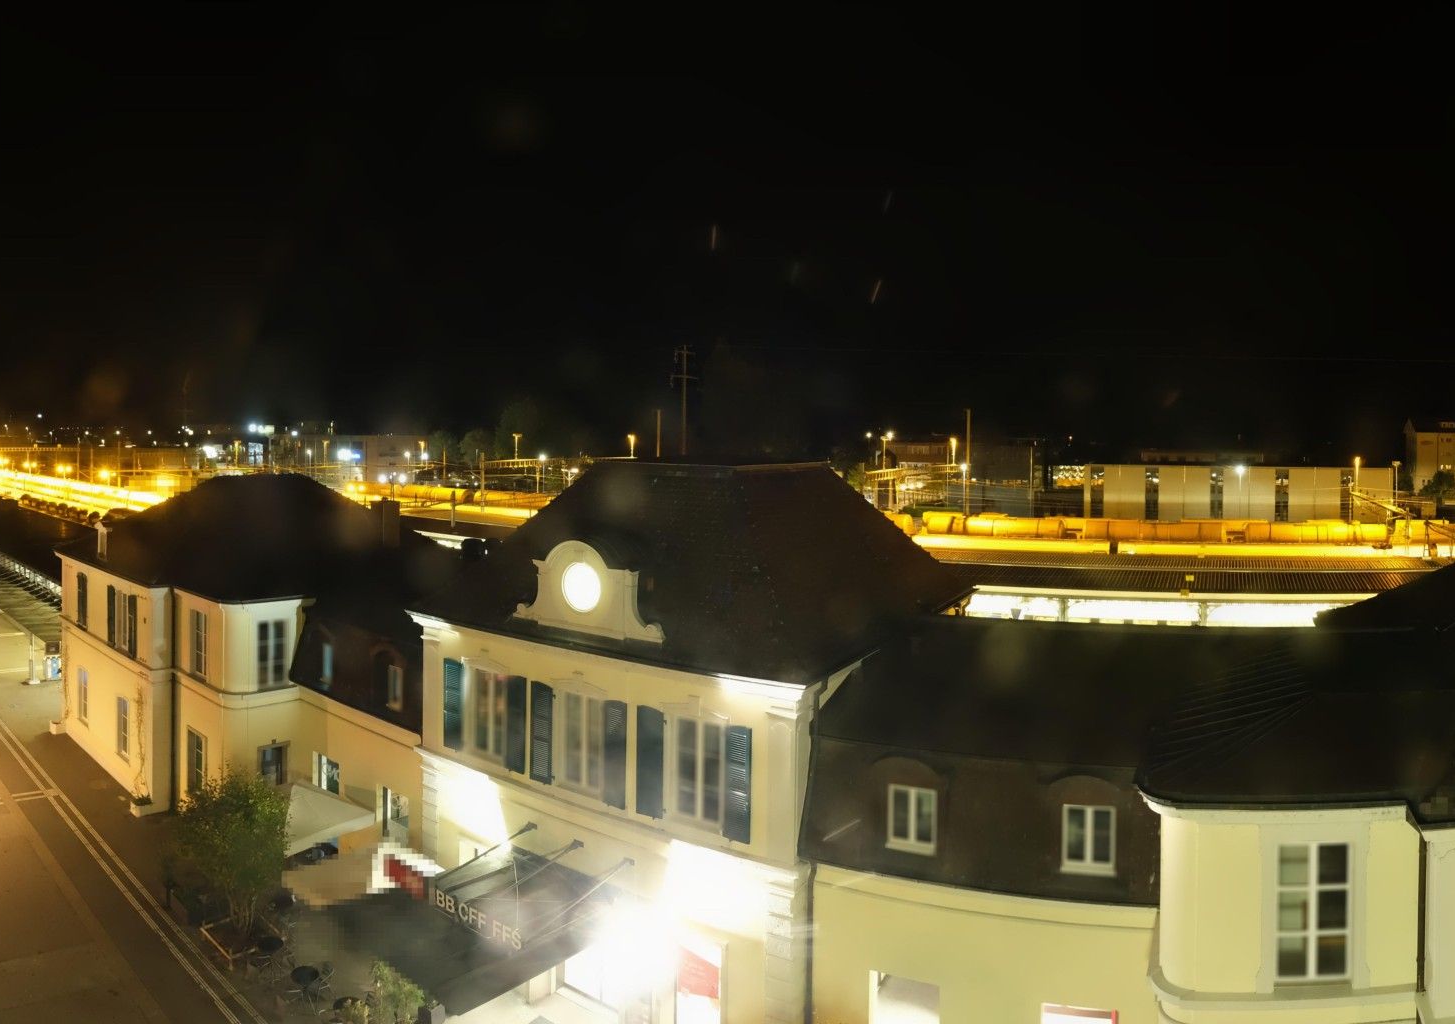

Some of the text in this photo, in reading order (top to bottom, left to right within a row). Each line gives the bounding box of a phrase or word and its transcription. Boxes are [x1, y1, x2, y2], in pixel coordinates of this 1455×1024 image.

[432, 887, 522, 952] BB CFF FFS
